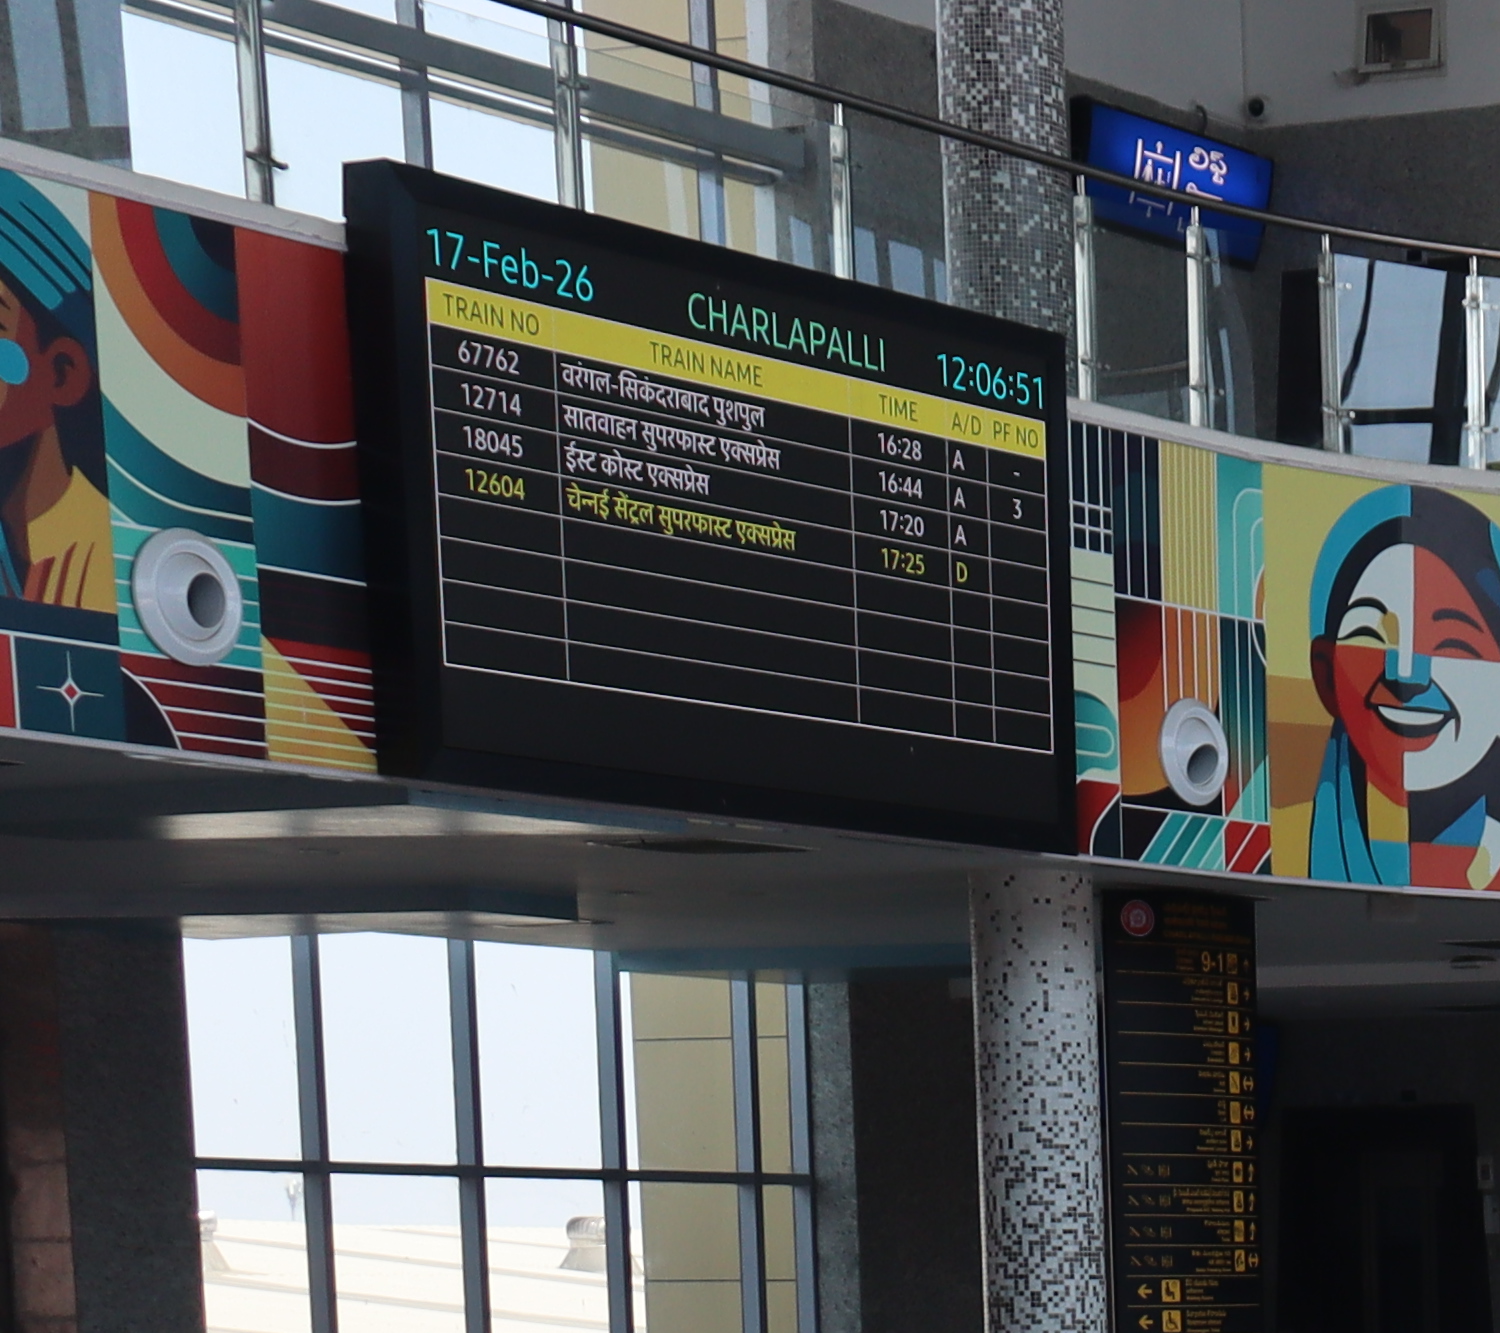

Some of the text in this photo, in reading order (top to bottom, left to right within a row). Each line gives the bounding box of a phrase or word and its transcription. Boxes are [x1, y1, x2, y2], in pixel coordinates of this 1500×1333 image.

[427, 228, 594, 302] 17-Feb-26
[442, 293, 541, 337] TRAIN NO
[688, 292, 886, 373] CHARLAPALLI
[458, 339, 520, 375] 67762
[650, 341, 764, 388] TRAIN NAME
[936, 353, 1045, 411] 12:06:51
[459, 382, 522, 417] 12714
[712, 396, 766, 431] पुशपुल
[878, 394, 919, 423] TIME
[561, 403, 782, 471] सातवाहन सुपरफास्ट एक्सप्रेस
[951, 411, 982, 436] A/D
[992, 420, 1039, 449] PF NO
[461, 425, 524, 460] 18045
[877, 432, 923, 462] 16:28
[563, 440, 711, 496] ईस्ट कोस्ट एक्सप्रेस
[952, 449, 966, 471] A
[464, 468, 526, 502] 12604
[878, 470, 924, 500] 16:44
[953, 486, 966, 509] A
[565, 481, 797, 551] चेन्नई सेंट्रल सुपरफास्ट एक्सप्रेस
[879, 509, 925, 538] 17:20
[1012, 498, 1023, 520] 3
[954, 524, 968, 547] A
[880, 546, 926, 576] 17:25
[956, 561, 969, 583] D
